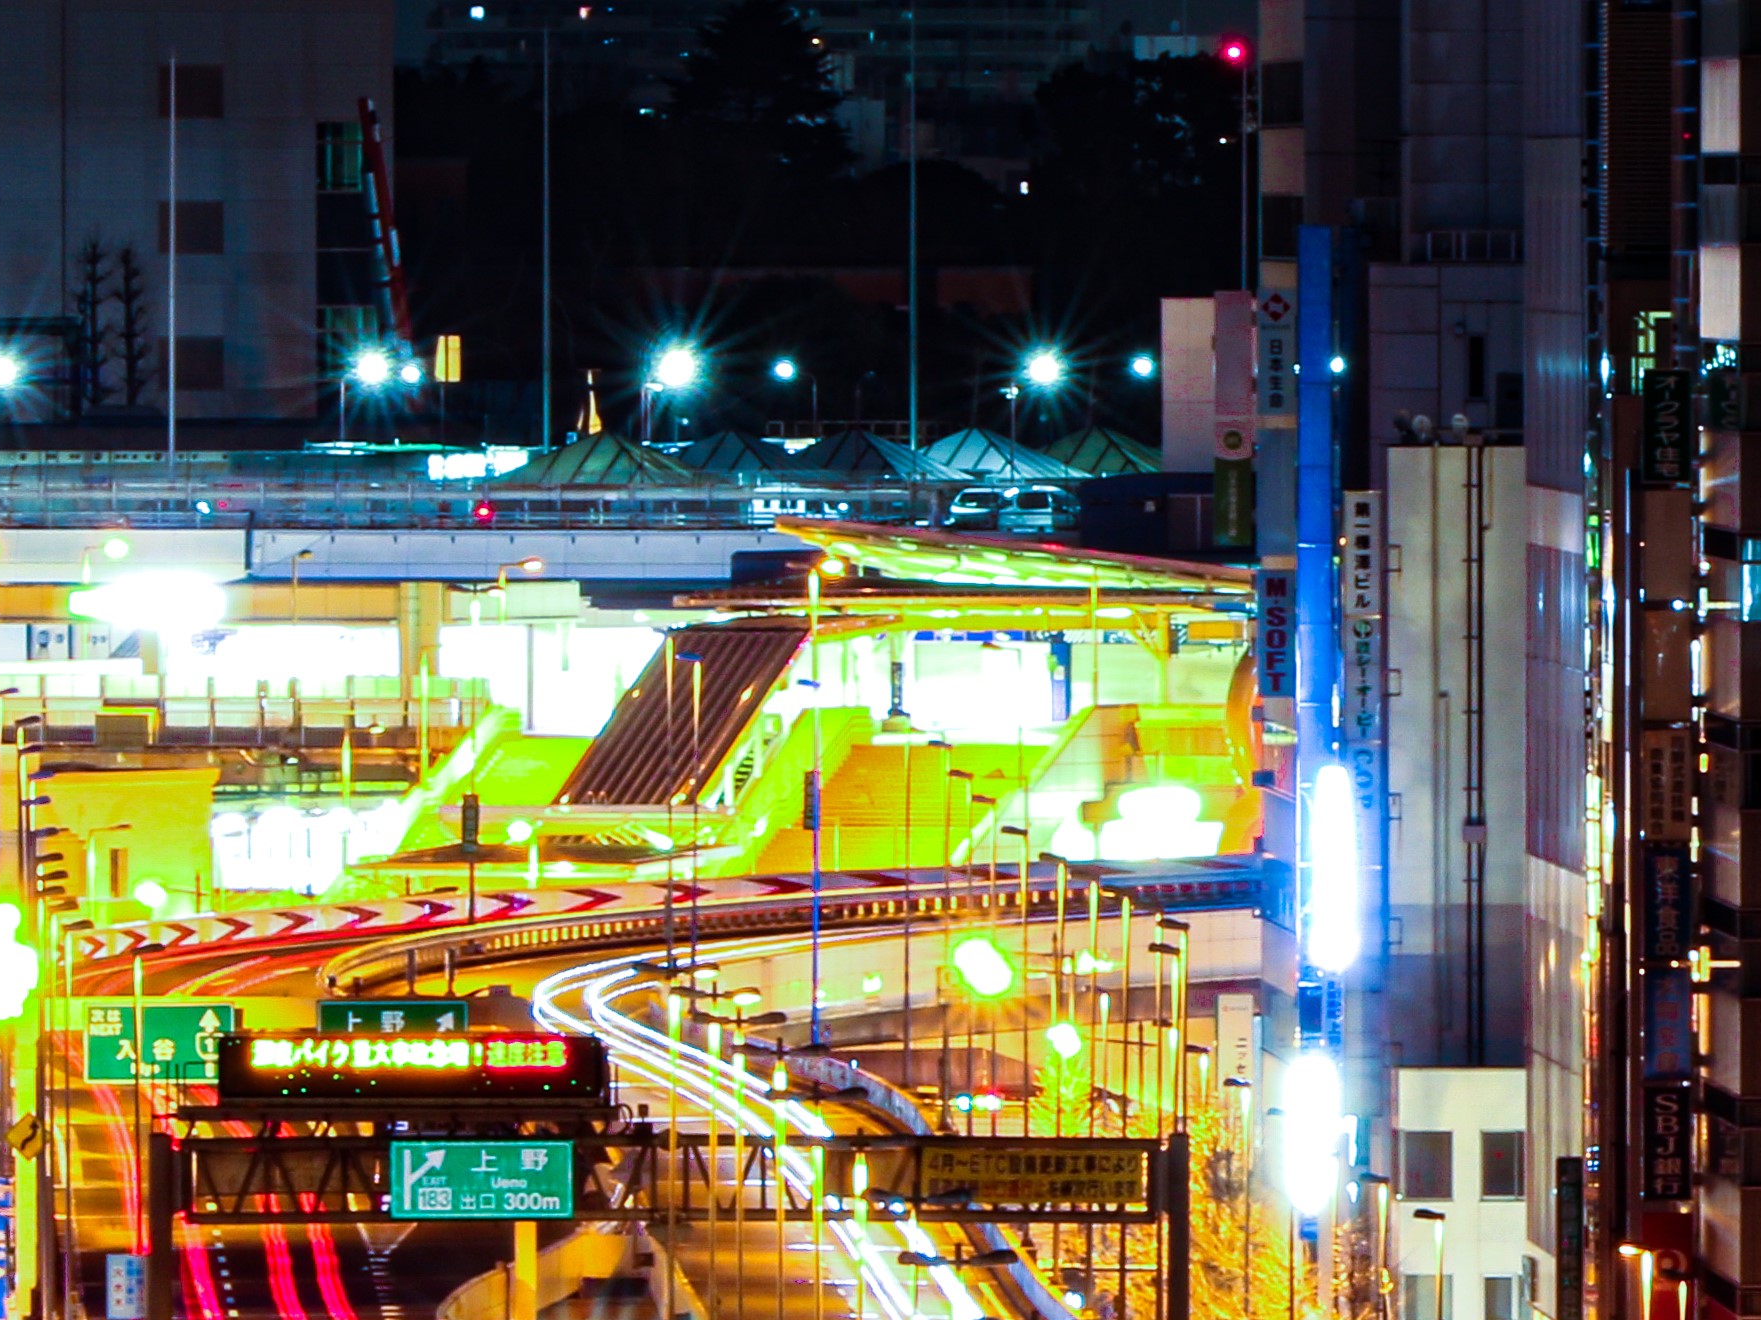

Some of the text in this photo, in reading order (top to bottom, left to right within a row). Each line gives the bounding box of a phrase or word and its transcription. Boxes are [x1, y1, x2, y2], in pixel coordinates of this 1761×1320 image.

[1268, 339, 1284, 408] 日本生命
[88, 1023, 122, 1036] NEXT
[1652, 1092, 1683, 1196] SBJ銀行
[471, 1147, 549, 1172] 上野
[422, 1177, 448, 1188] EXIT
[491, 1176, 528, 1189] Ueno
[419, 1190, 451, 1208] 183
[459, 1191, 560, 1212] 出口 300m
